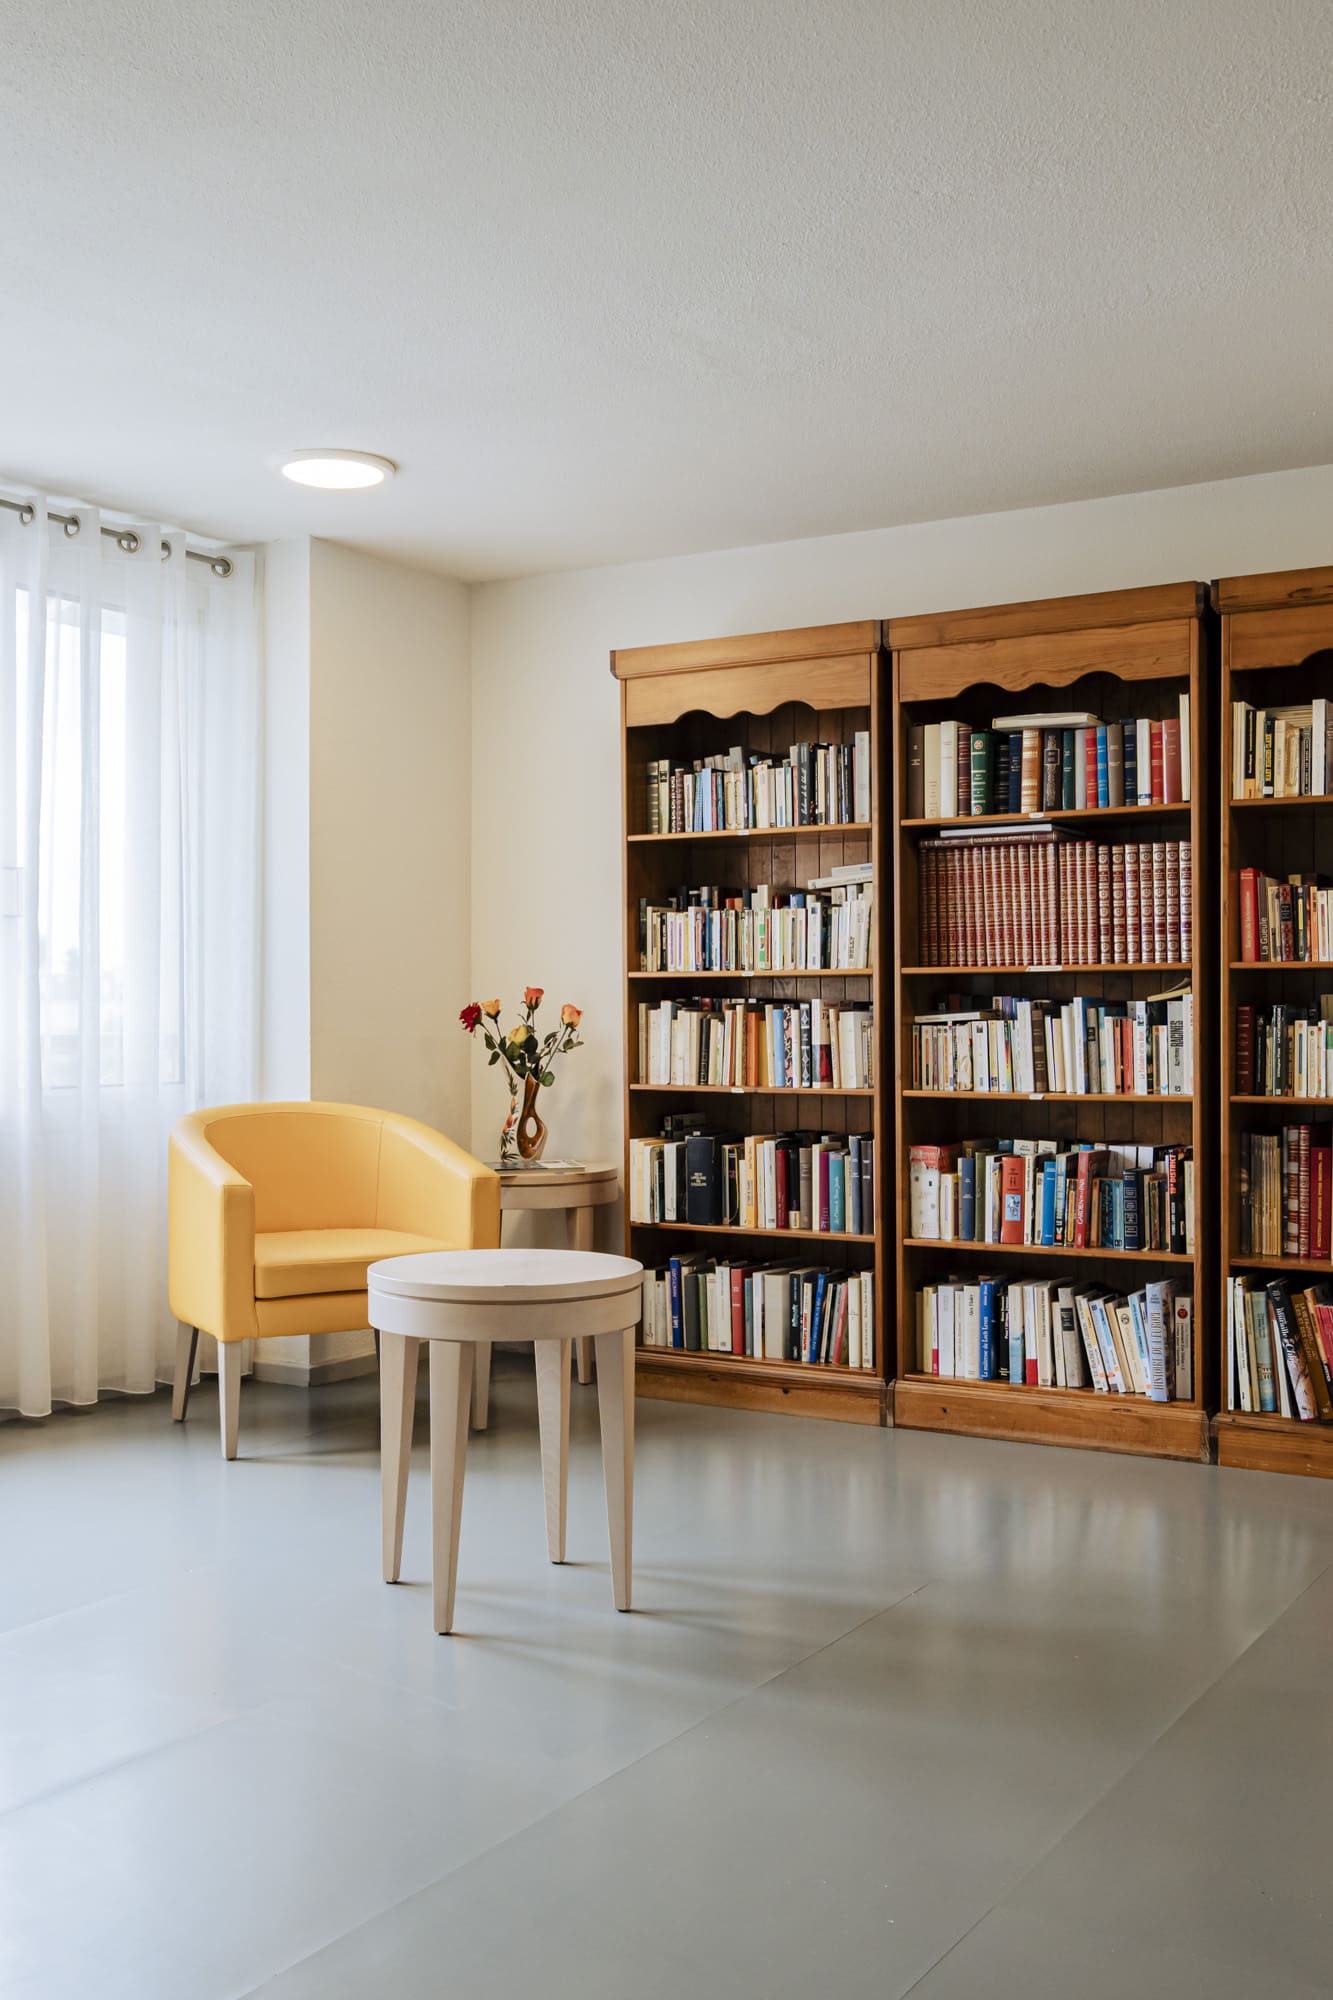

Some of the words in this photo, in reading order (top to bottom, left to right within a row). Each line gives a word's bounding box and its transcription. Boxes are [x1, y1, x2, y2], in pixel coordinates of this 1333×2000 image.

[1260, 917, 1269, 944] Gueule
[1261, 945, 1269, 955] La
[1170, 1020, 1184, 1047] RACINES
[1151, 1346, 1162, 1355] DE
[1152, 1358, 1164, 1390] HISTOIRE
